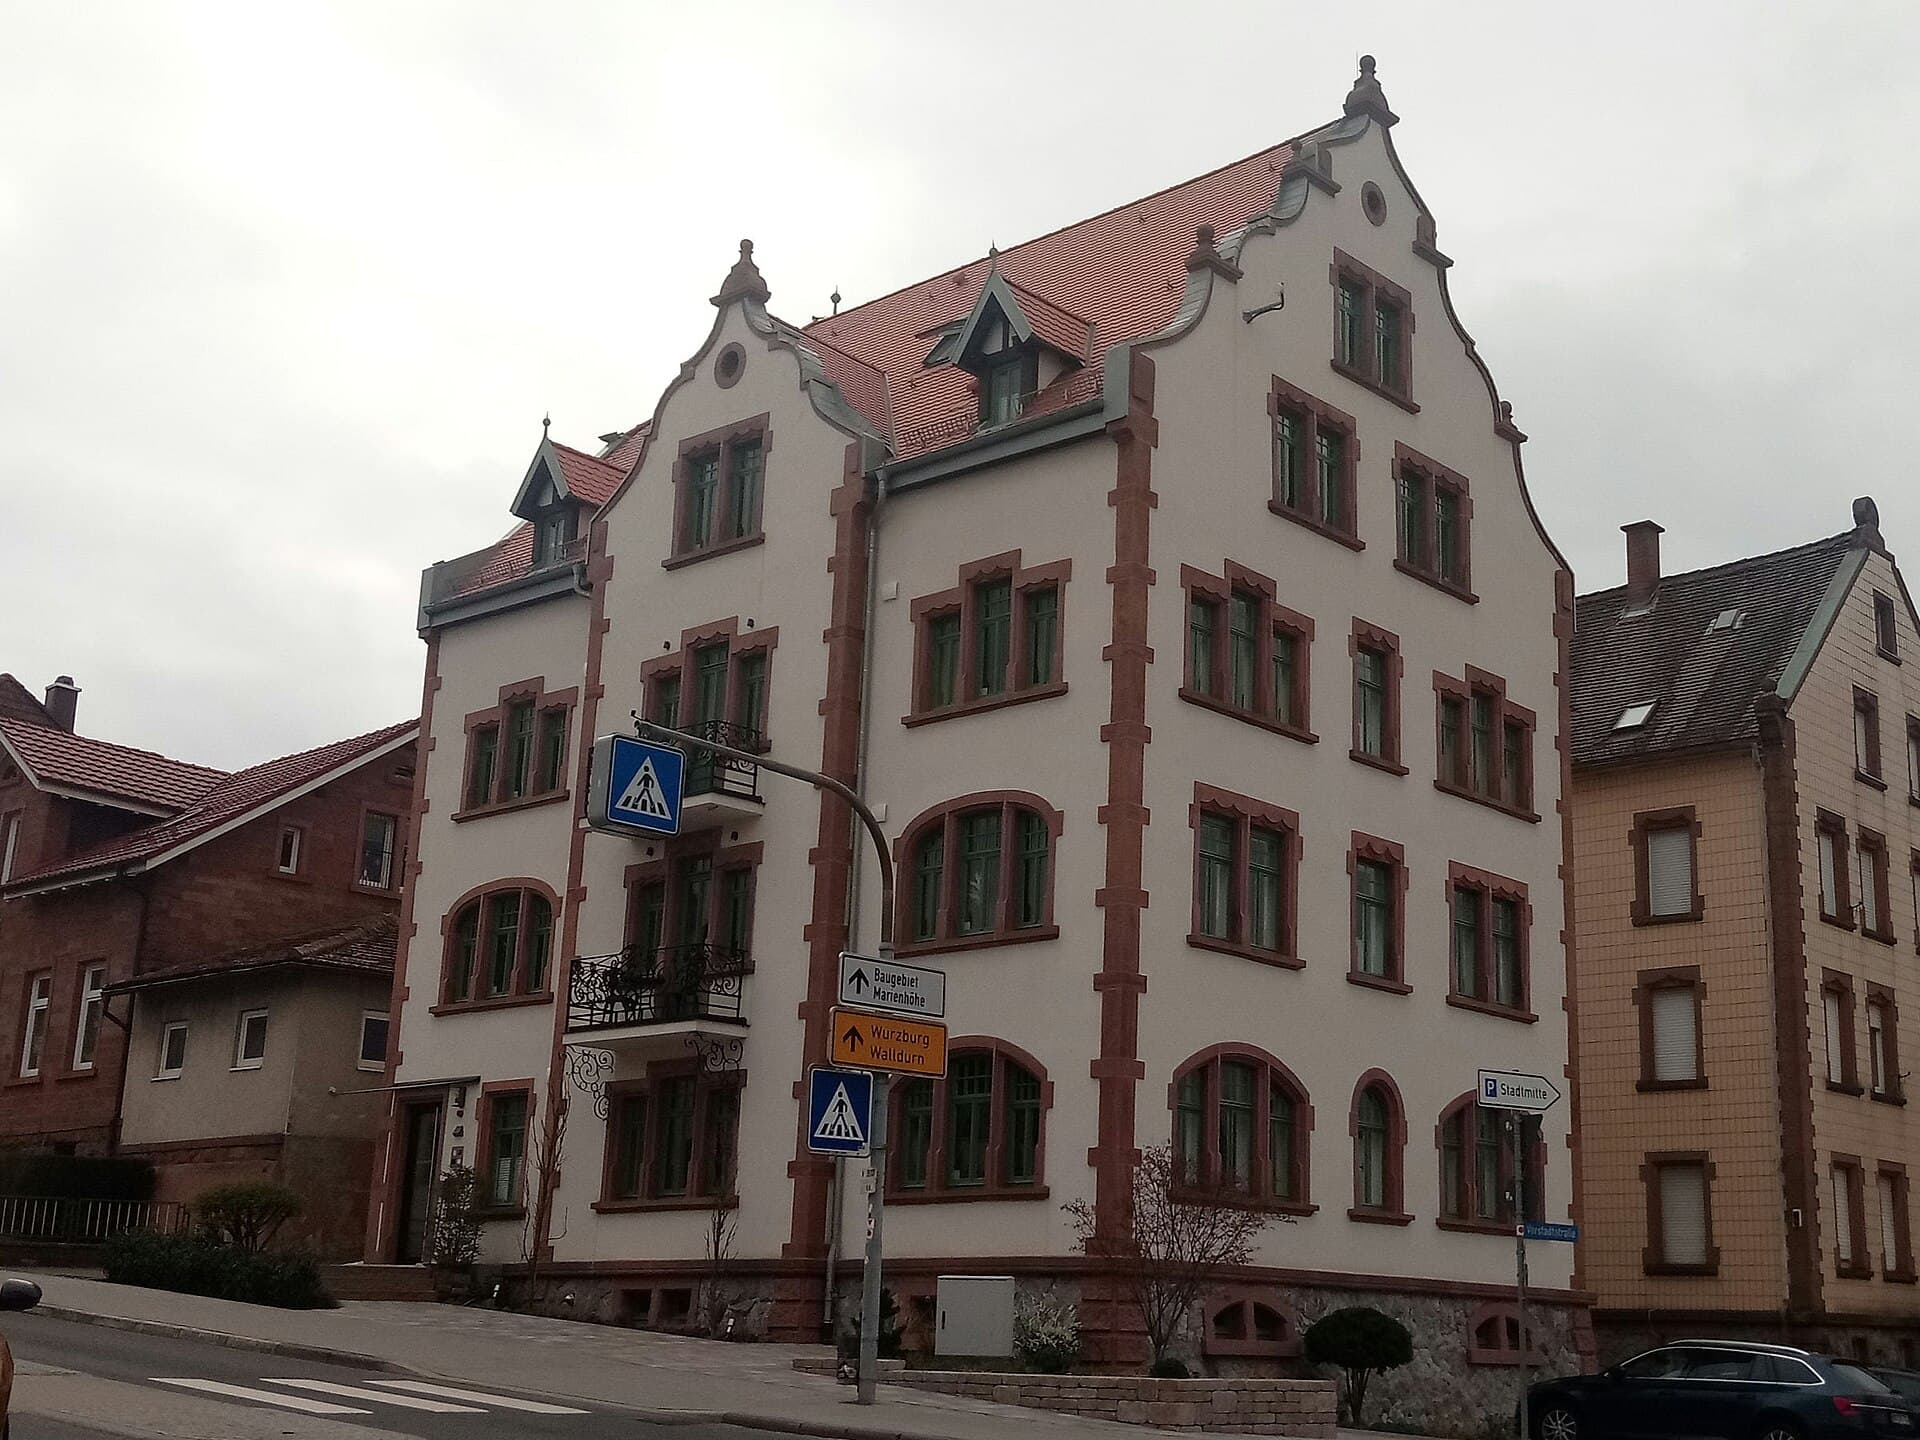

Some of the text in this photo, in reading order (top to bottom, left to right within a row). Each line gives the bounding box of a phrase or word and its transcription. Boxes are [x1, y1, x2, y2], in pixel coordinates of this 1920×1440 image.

[874, 967, 919, 988] Baugebiet
[873, 986, 926, 1008] Marienhöhe
[1487, 1080, 1548, 1100] P Stadtmitte
